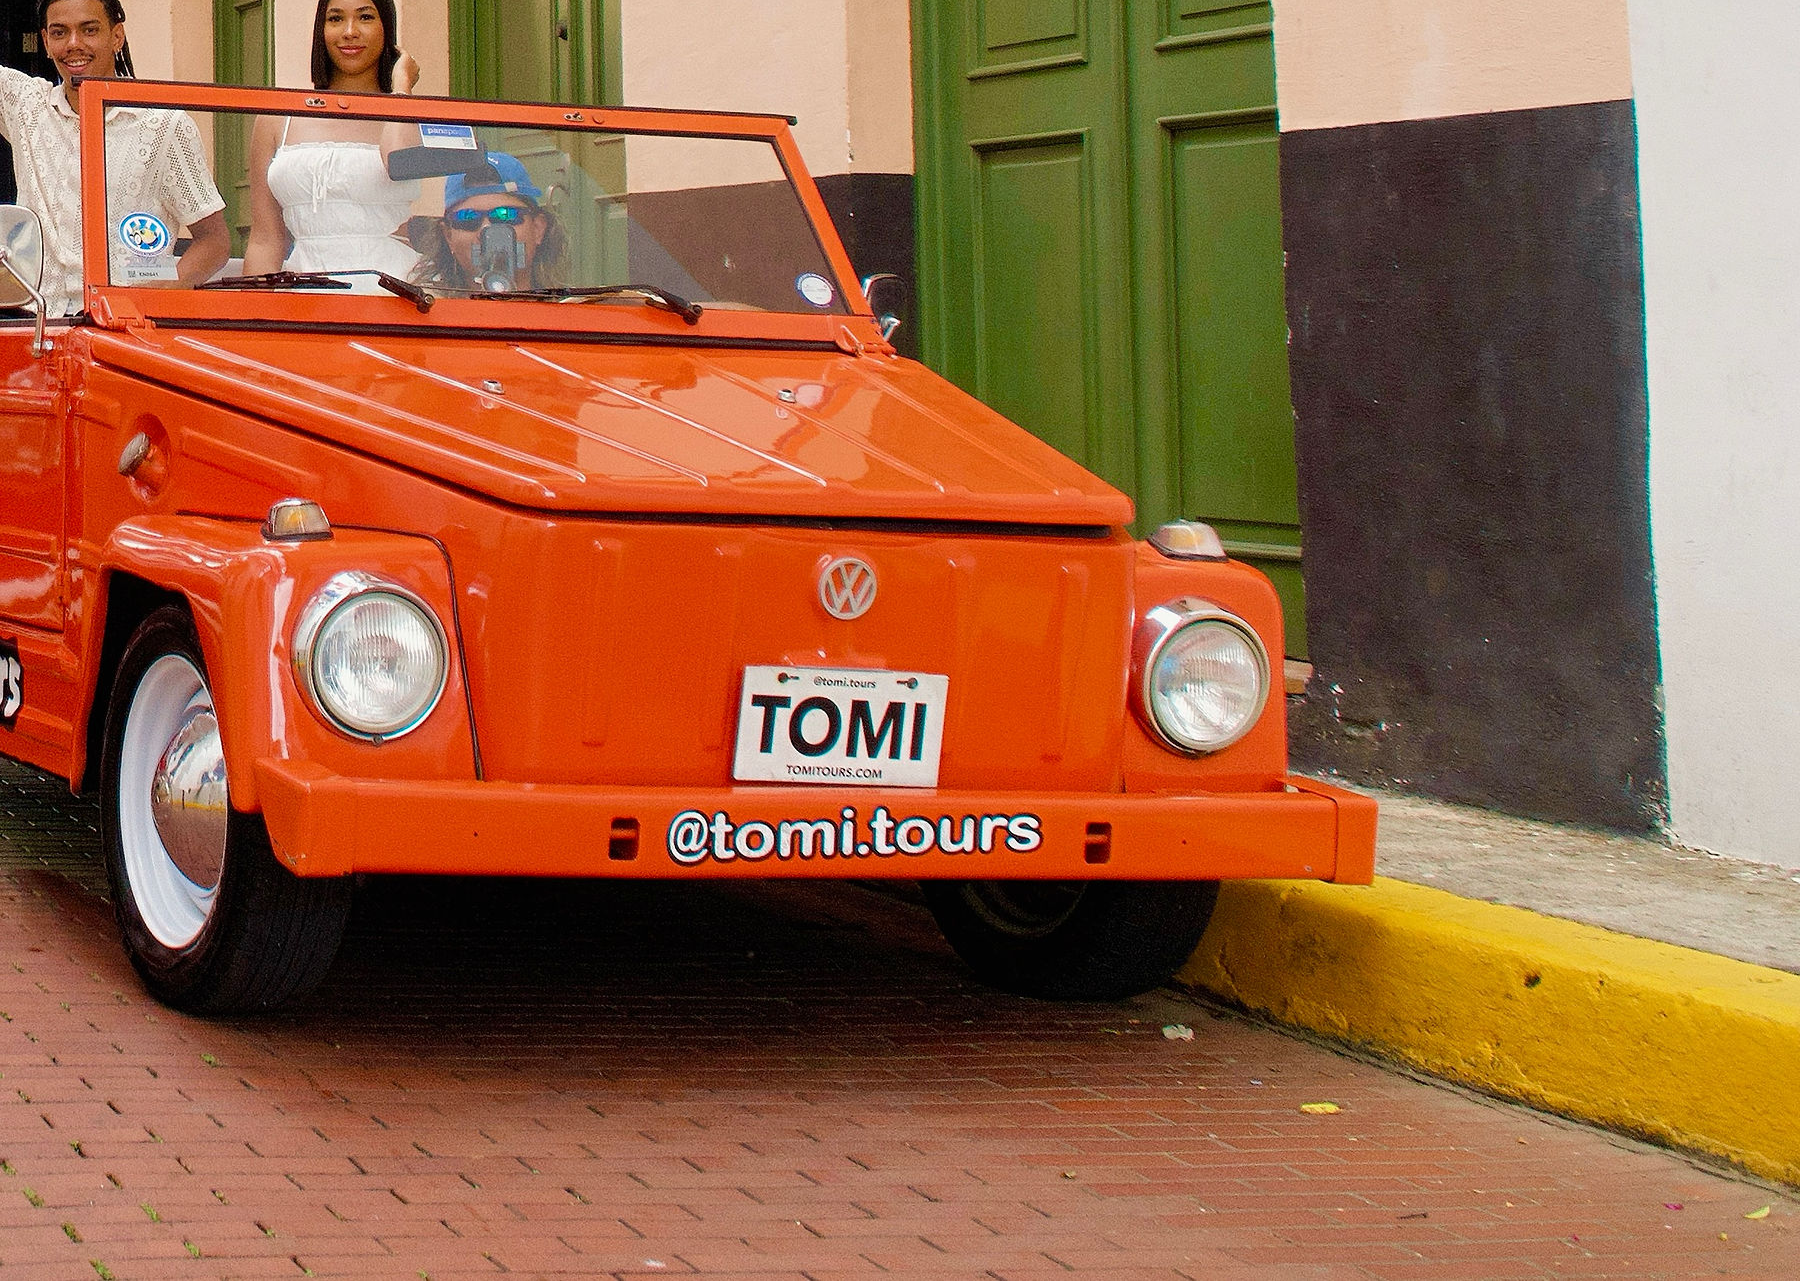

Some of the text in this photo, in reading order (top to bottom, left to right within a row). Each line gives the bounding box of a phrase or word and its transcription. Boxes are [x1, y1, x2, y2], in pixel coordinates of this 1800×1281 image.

[813, 675, 877, 690] @tomi.tours
[751, 694, 928, 762] TOMI
[786, 763, 883, 780] TOMITOURS.COM
[666, 806, 1043, 865] @tomi.tours
